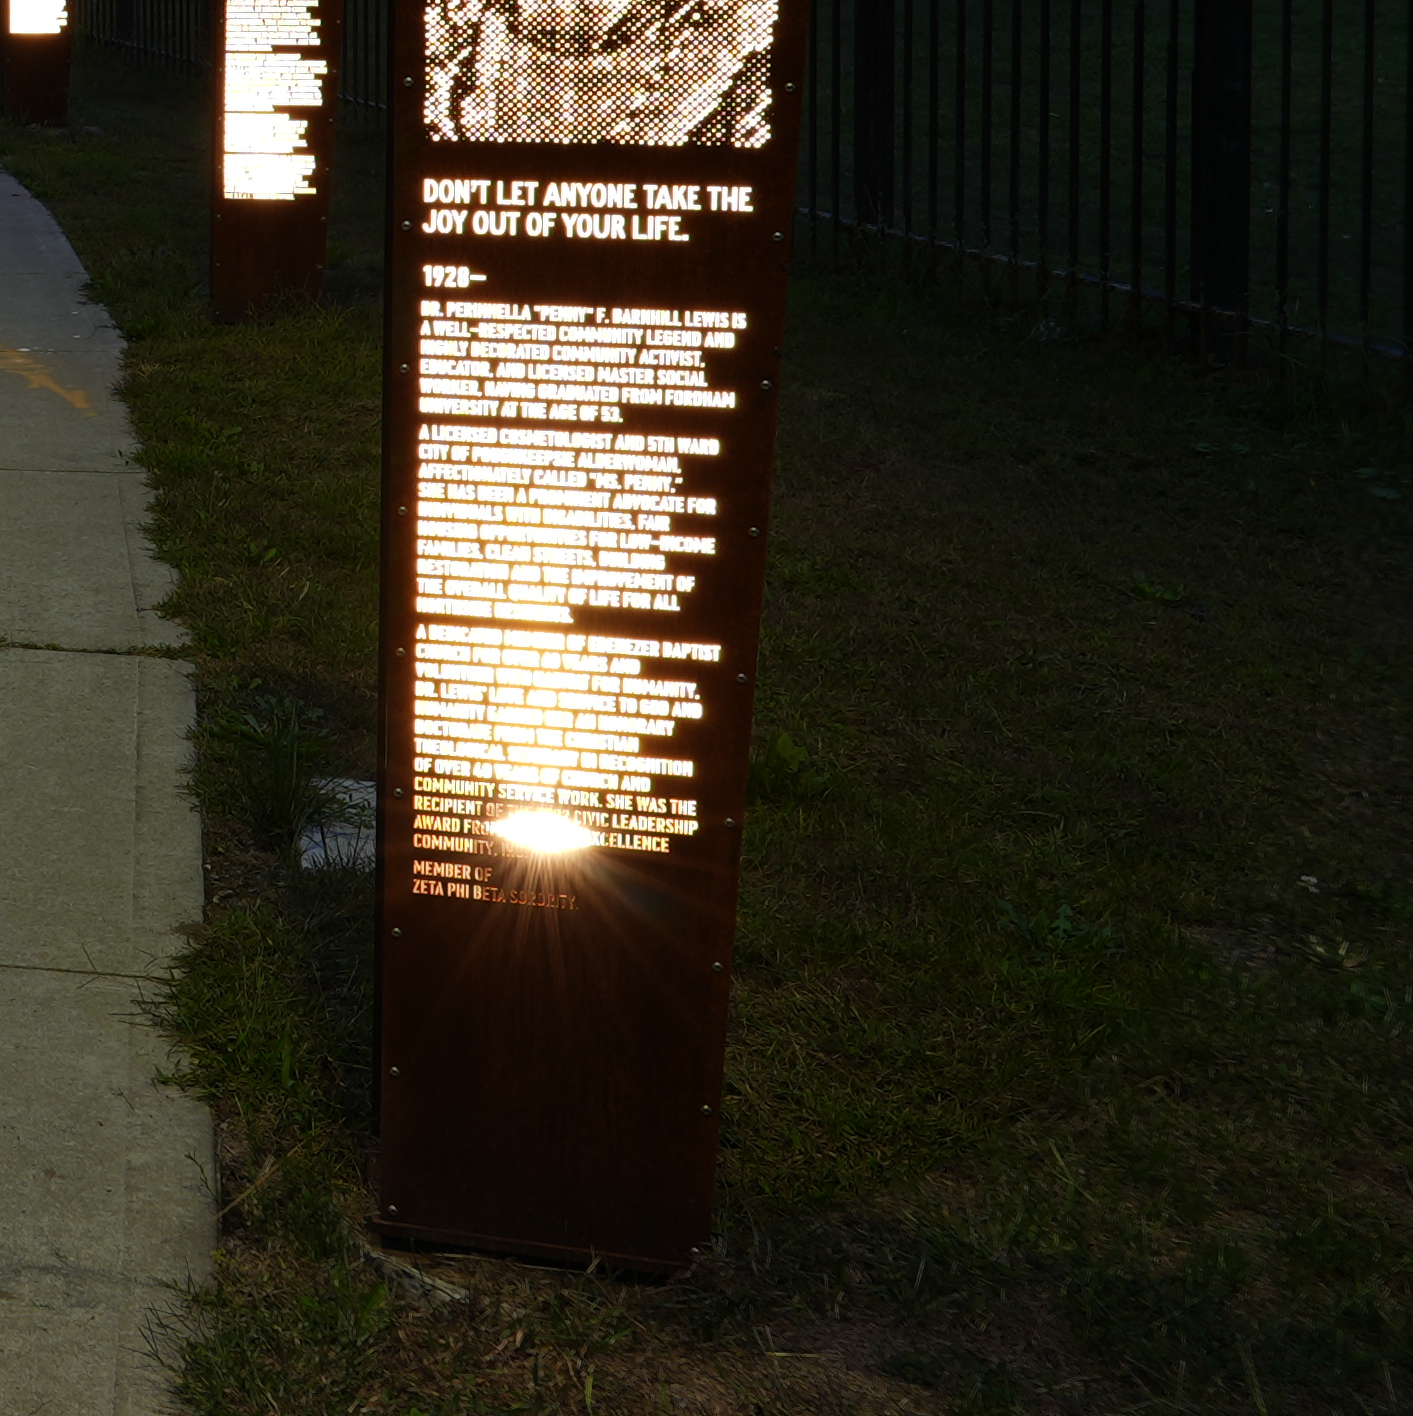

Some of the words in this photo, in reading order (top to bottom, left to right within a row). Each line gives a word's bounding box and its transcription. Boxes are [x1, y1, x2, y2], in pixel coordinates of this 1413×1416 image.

[424, 179, 491, 205] DON’T
[497, 180, 539, 207] LET
[543, 181, 637, 209] ANYONE
[643, 184, 701, 211] TAKE
[707, 185, 753, 212] THE
[423, 209, 468, 234] JOY
[473, 210, 521, 236] OUT
[526, 211, 557, 237] OF
[562, 212, 626, 240] YOUR
[632, 214, 689, 242] LIFE.
[421, 301, 444, 316] DR.
[596, 307, 610, 323] F.
[612, 308, 682, 326] BARNHILL
[685, 310, 729, 328] LEWIS
[732, 312, 747, 329] IS
[421, 320, 431, 335] A
[559, 326, 644, 345] COMMUNITY
[646, 329, 702, 347] LEGEND
[704, 331, 735, 349] AND
[471, 341, 550, 360] DECORATED
[552, 344, 636, 363] COMMUNITY
[496, 362, 526, 379] AND
[528, 363, 595, 382] LICENSED
[597, 366, 654, 385] MASTER
[657, 369, 708, 388] SOCIAL
[538, 383, 619, 403] GRADUATED
[622, 387, 662, 405] FROM
[665, 389, 735, 408] FORDHAM
[420, 397, 499, 416] UNIVERSITY
[501, 401, 519, 417] AT
[520, 402, 547, 419] THE
[549, 403, 577, 420] AGE
[580, 405, 599, 421] OF
[419, 424, 430, 440] A
[615, 434, 645, 452] AND
[647, 435, 675, 453] 5TH
[677, 437, 720, 456] WARD
[419, 443, 449, 460] CITY
[451, 445, 470, 461] OF
[534, 468, 587, 487] CALLED
[516, 487, 527, 504] A
[613, 492, 685, 513] ADVOCATE
[687, 496, 717, 515] FOR
[676, 575, 695, 593] OF
[589, 588, 620, 607] LIFE
[653, 592, 680, 611] ALL
[417, 624, 427, 639] A
[662, 641, 721, 662] BAPTIST
[414, 757, 433, 774] OF
[435, 758, 471, 777] OVER
[621, 774, 651, 794] AND
[414, 776, 496, 798] COMMUNITY
[498, 783, 555, 804] SERVICE
[557, 788, 603, 808] WORK.
[606, 792, 633, 811] SHE
[636, 795, 668, 814] WAS
[669, 798, 697, 816] THE
[414, 795, 483, 816] RECIPIENT
[485, 801, 504, 818] OF
[573, 809, 610, 828] CIVIC
[612, 812, 700, 837] LEADERSHIP
[414, 814, 461, 833] AWARD
[413, 860, 471, 880] MEMBER
[474, 865, 493, 882] OF
[412, 878, 444, 897] ZETA
[447, 882, 470, 899] PHI
[473, 884, 507, 903] BETA
